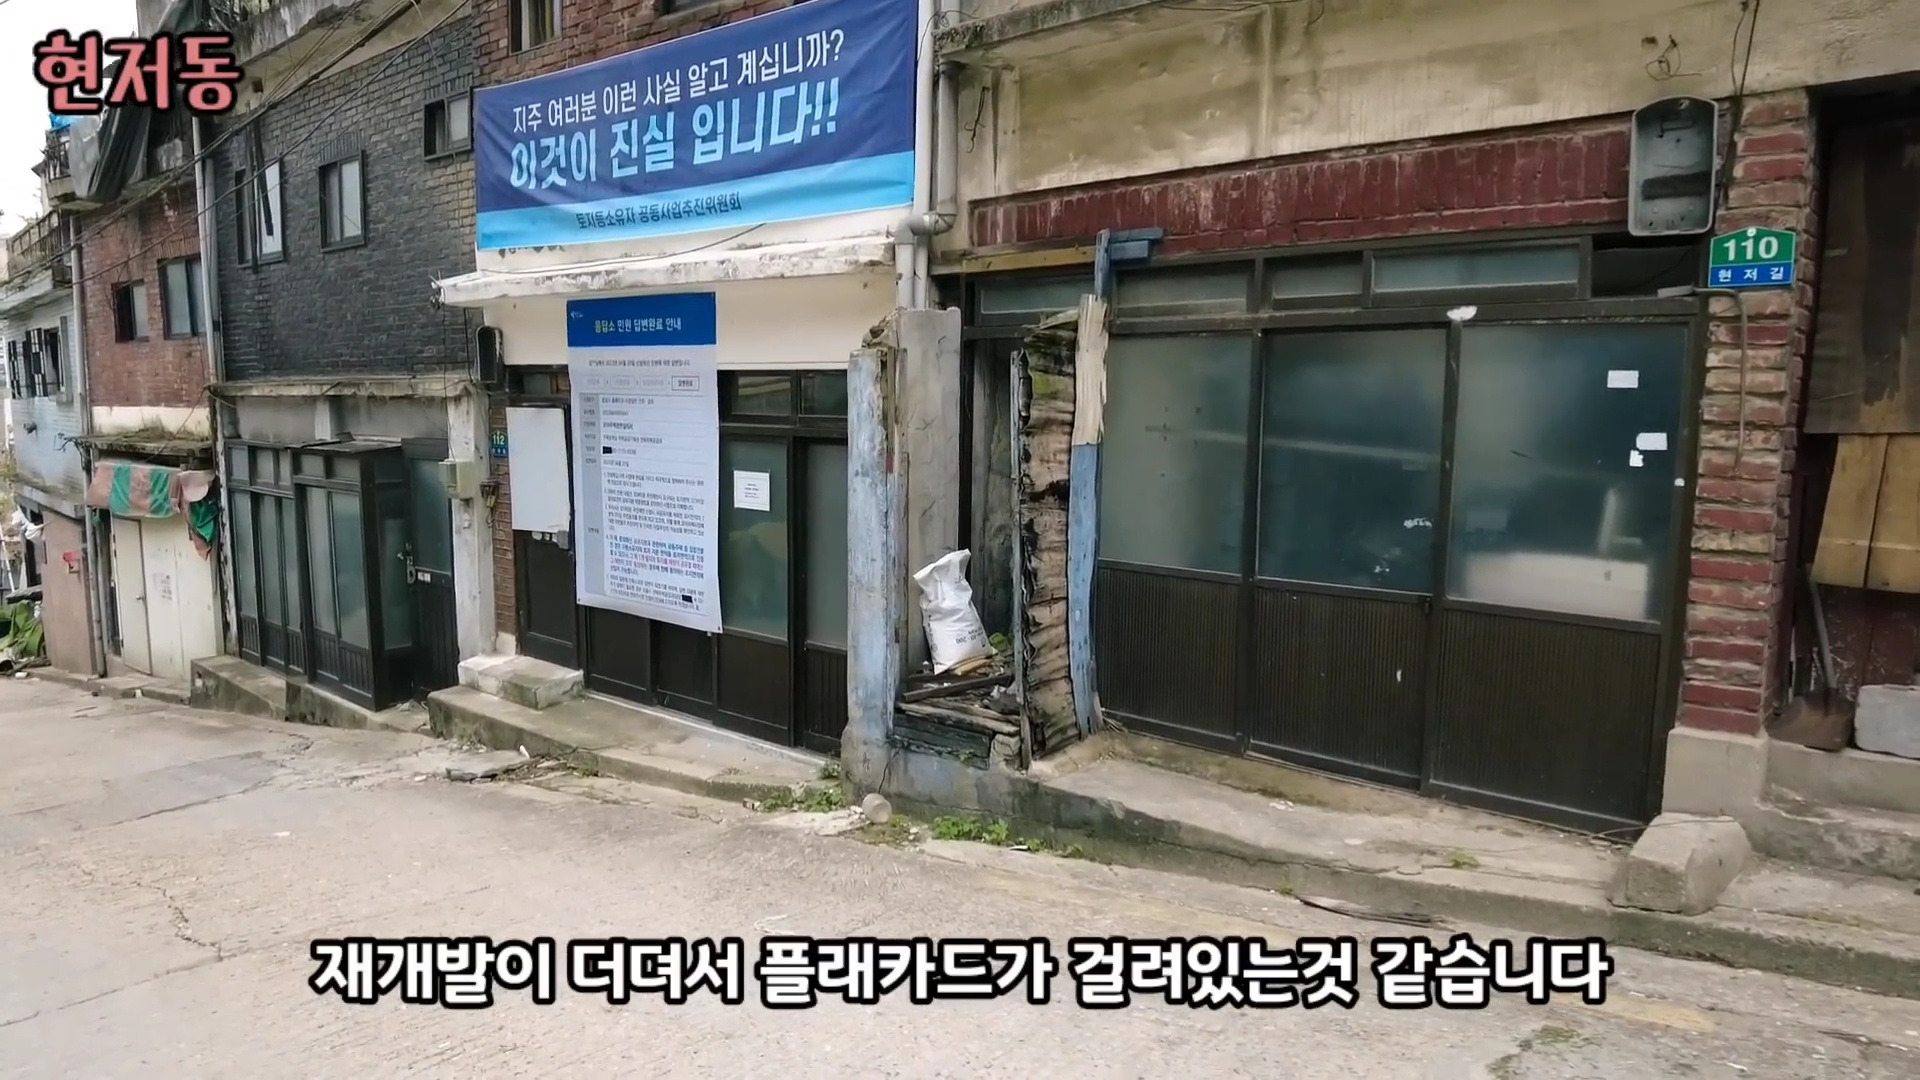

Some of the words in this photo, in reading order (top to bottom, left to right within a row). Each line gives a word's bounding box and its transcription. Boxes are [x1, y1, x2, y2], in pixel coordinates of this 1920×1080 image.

[513, 103, 542, 133] 지주
[548, 90, 597, 127] 여러분
[602, 80, 637, 115] 이런
[643, 69, 681, 106] 사실
[688, 57, 729, 98] 알고
[737, 29, 845, 86] 계십니까?
[510, 128, 597, 190] 이것이
[610, 111, 675, 178] 진실
[692, 77, 840, 165] 입니다!!
[576, 206, 637, 229] 토지등소유자
[638, 191, 743, 224] 공동사업추진위원회
[1722, 236, 1779, 261] 110
[665, 316, 682, 331] 안내
[492, 433, 505, 445] 112
